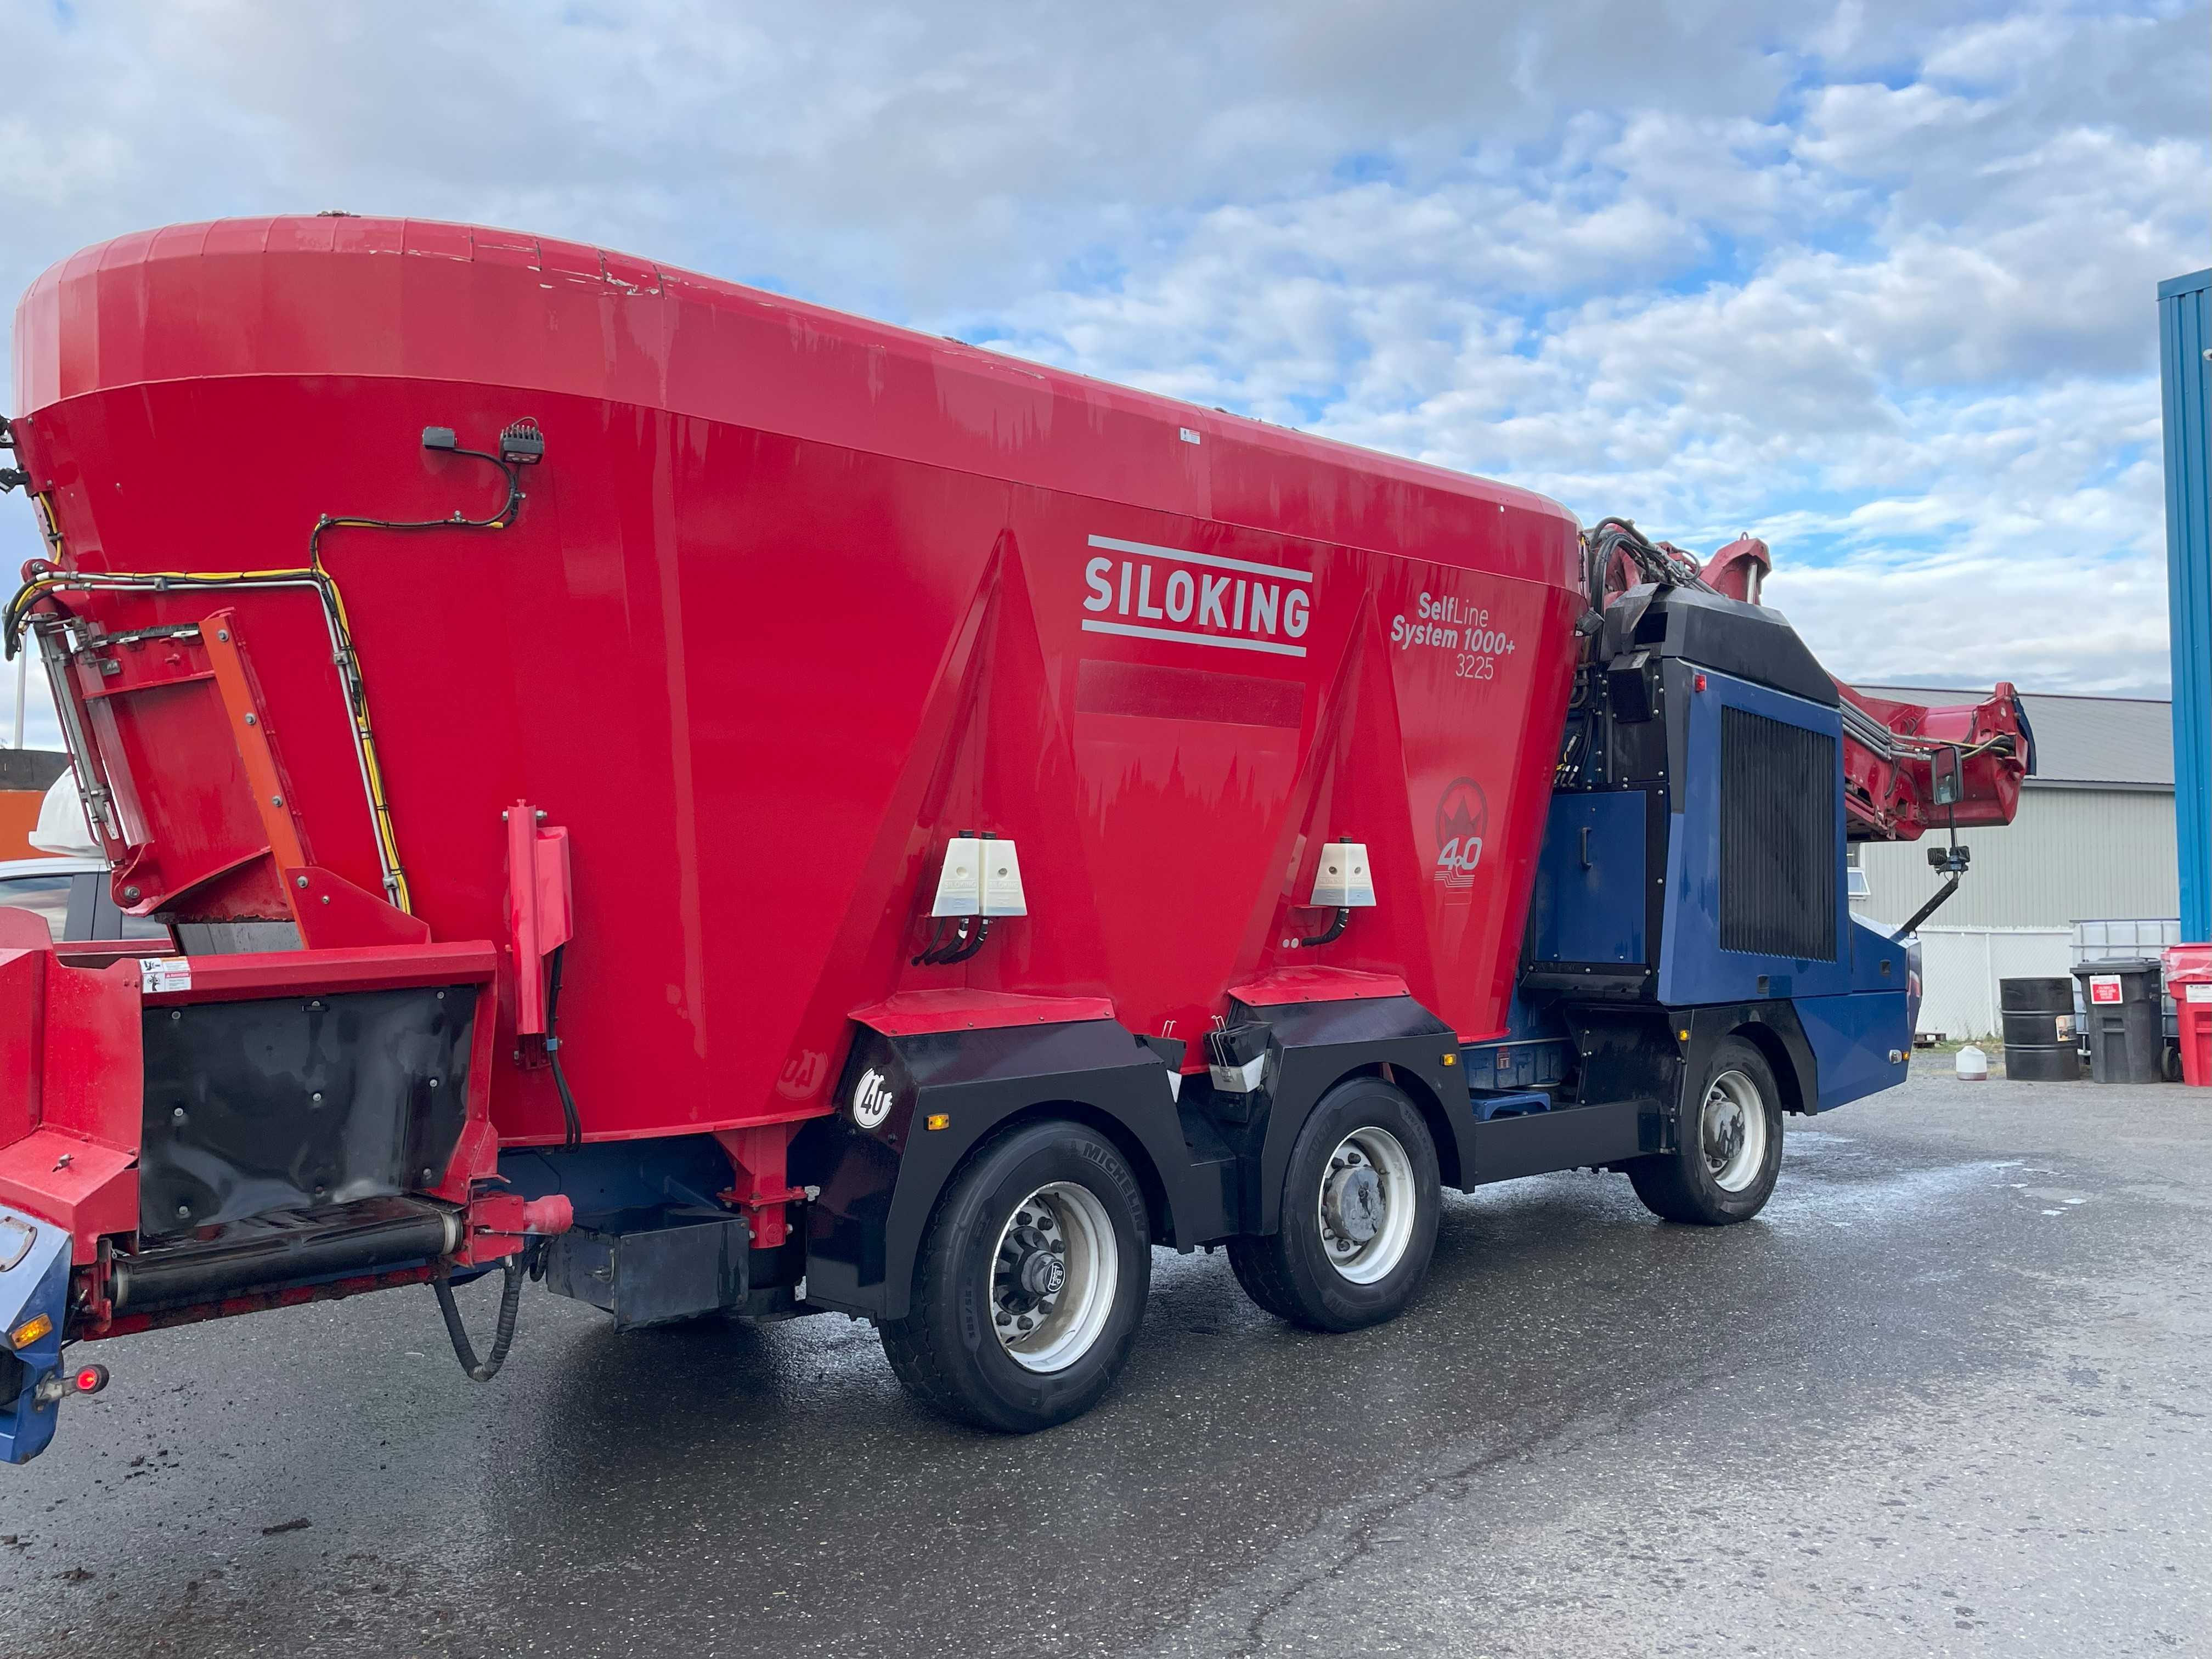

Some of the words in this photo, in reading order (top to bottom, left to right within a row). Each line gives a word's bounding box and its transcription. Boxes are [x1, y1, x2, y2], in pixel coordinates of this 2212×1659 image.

[1083, 557, 1310, 637] SILOKING
[1418, 592, 1488, 627] SelfLine
[1391, 614, 1458, 650] System
[1464, 628, 1515, 654] 1000+
[1455, 653, 1494, 680] 3225
[1082, 1142, 1146, 1232] MICHELIN
